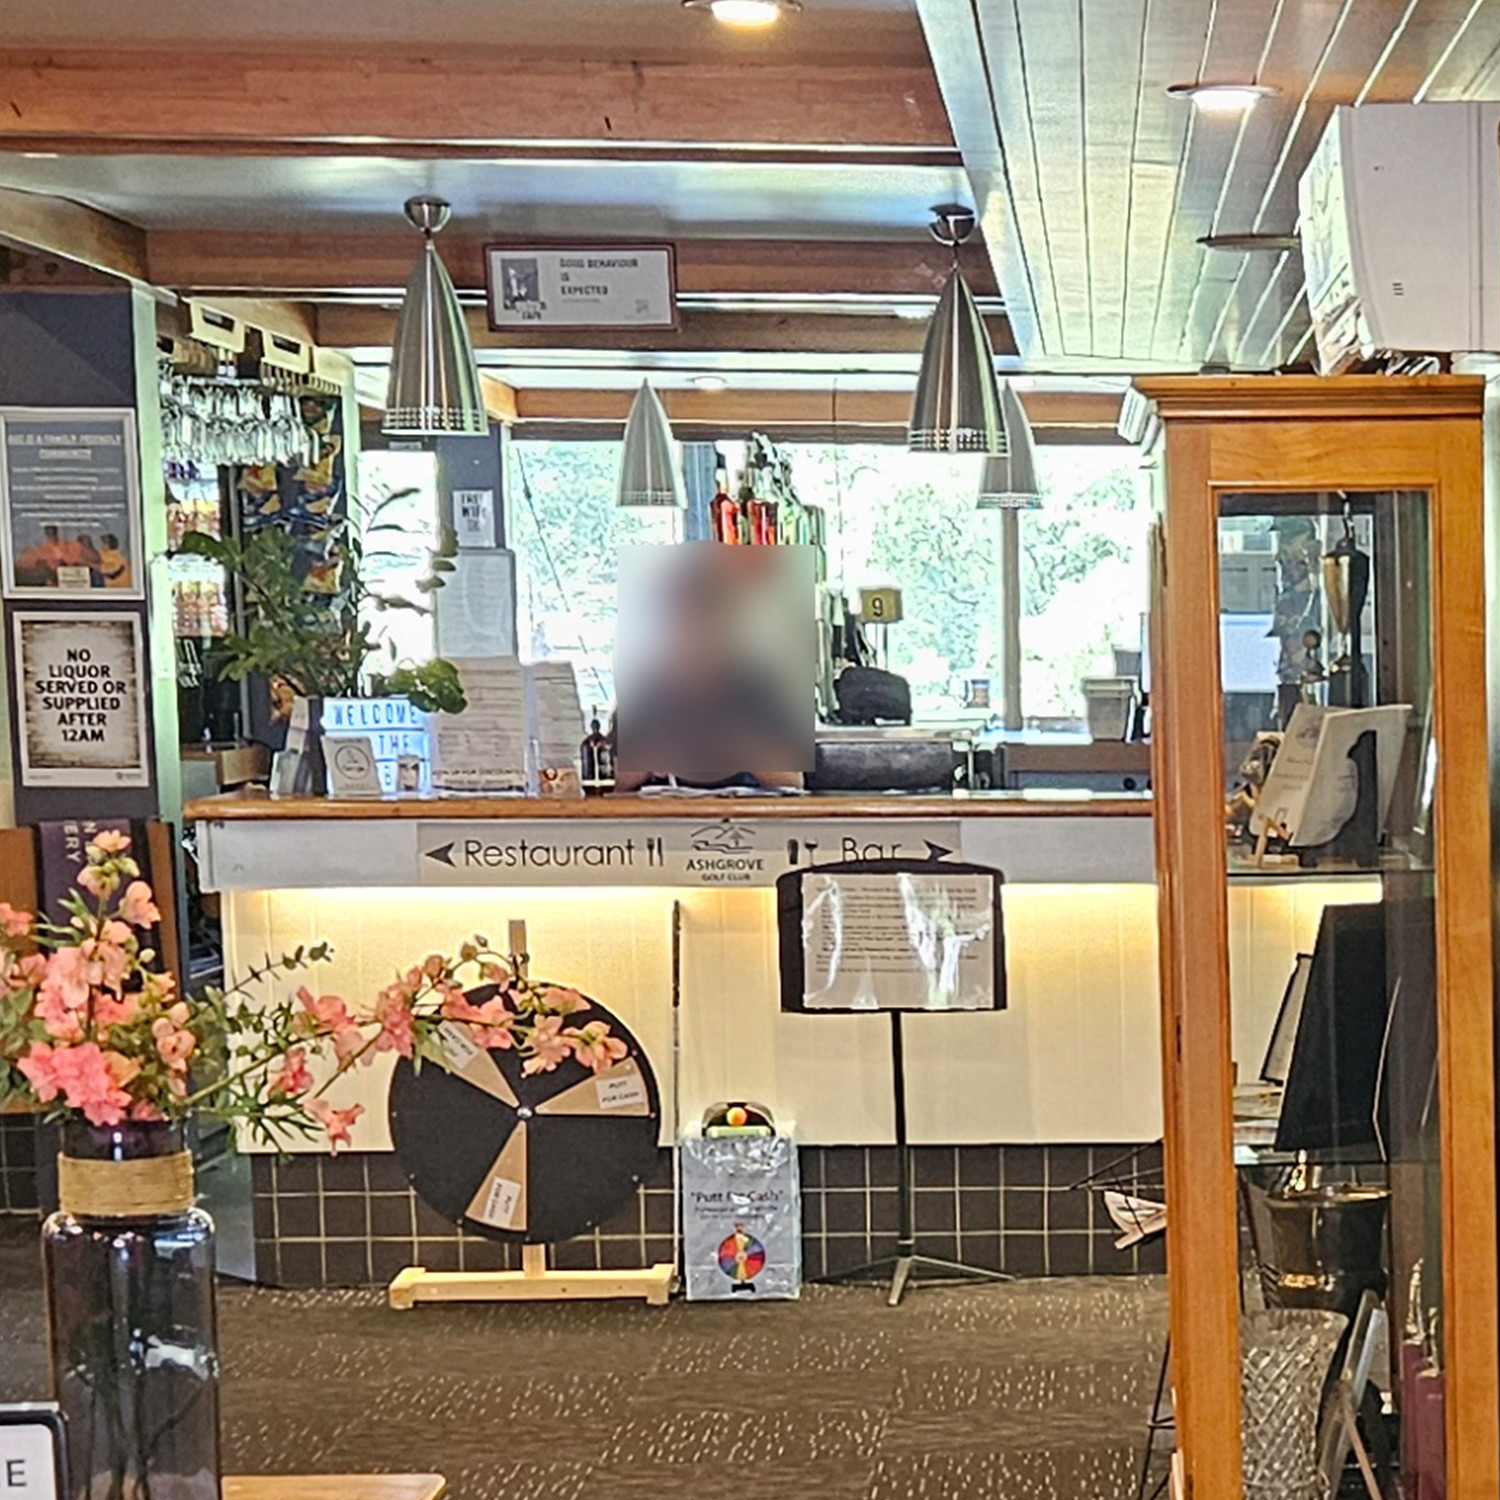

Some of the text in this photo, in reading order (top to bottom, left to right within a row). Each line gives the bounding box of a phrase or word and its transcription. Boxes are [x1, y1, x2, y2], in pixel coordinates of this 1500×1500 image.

[587, 258, 639, 268] BEHAVIOUR
[561, 285, 608, 295] EXPECTED
[872, 597, 883, 617] 9
[66, 648, 91, 662] NO
[48, 665, 111, 681] LIQUOR
[35, 680, 127, 694] SERVED OR
[42, 696, 121, 710] SUPPLIED
[57, 712, 107, 726] AFTER
[334, 702, 418, 726] WELCOME
[61, 728, 105, 742] 12AM
[64, 820, 81, 862] ERY
[463, 837, 635, 868] Restaurant
[842, 837, 902, 861] Bar
[686, 858, 764, 871] ASHGROVE
[702, 873, 751, 881] GOLF CLUB
[4, 1459, 27, 1487] E
